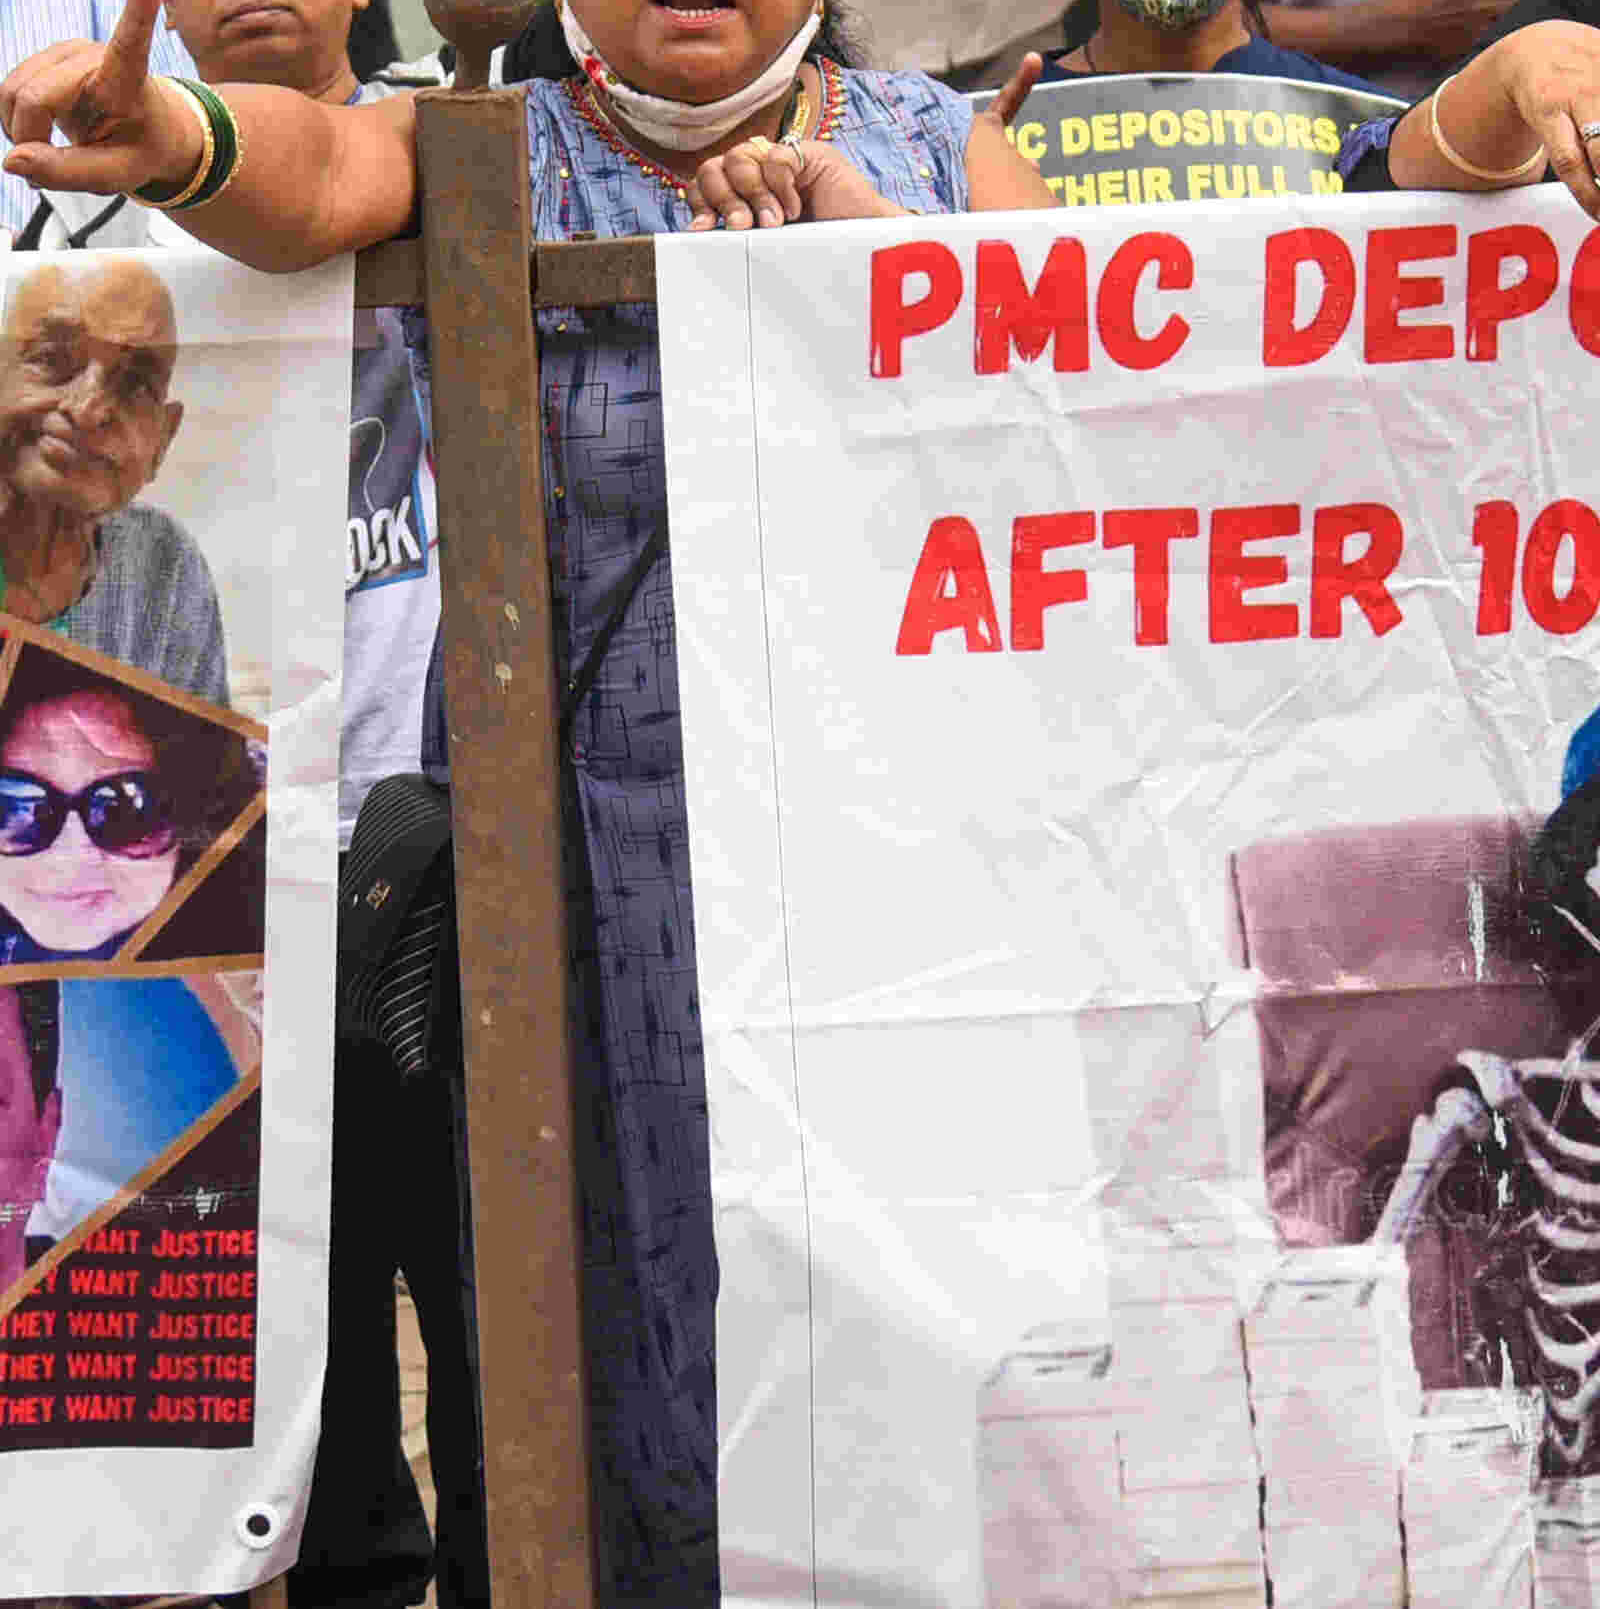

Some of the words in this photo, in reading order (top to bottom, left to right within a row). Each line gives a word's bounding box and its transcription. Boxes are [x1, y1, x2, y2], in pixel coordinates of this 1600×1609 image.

[1059, 109, 1342, 158] DEPOSITORS
[1186, 162, 1288, 201] FULL
[869, 230, 1193, 380] PMC
[896, 499, 1405, 657] AFTER
[151, 1228, 255, 1258] JUSTICE
[69, 1268, 141, 1297] WANT
[150, 1270, 255, 1300] JUSTICE
[67, 1310, 140, 1341] WANT
[149, 1311, 255, 1341] JUSTICE
[66, 1350, 137, 1382] WANT
[148, 1352, 253, 1383] JUSTICE
[64, 1394, 137, 1424] WANT
[147, 1394, 253, 1425] JUSTICE
